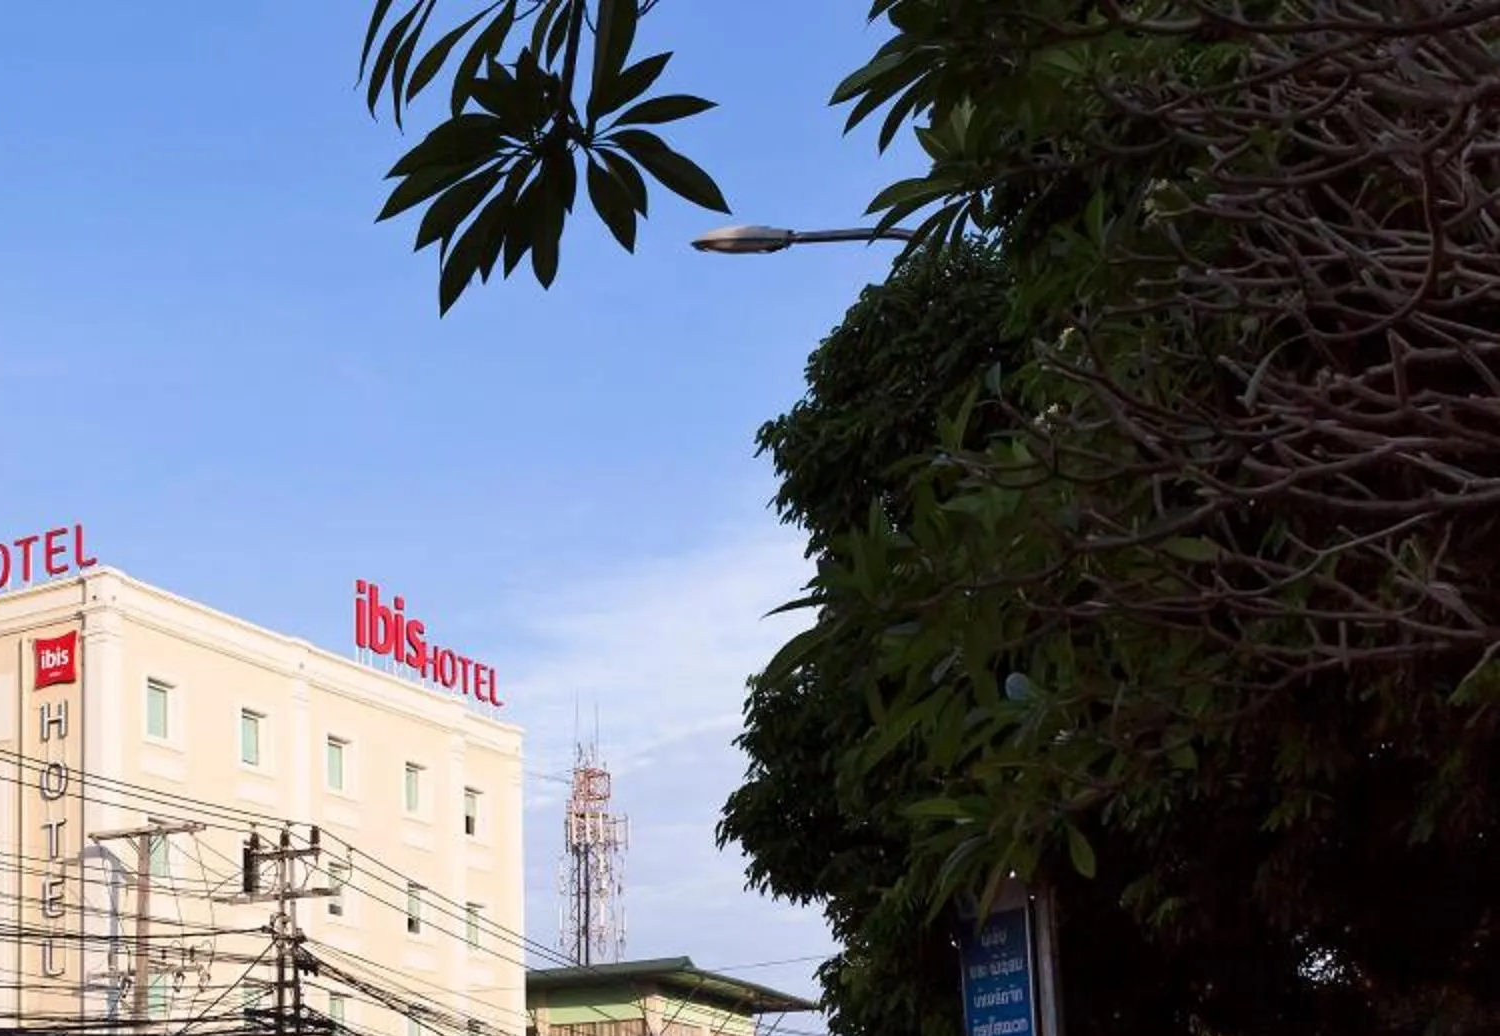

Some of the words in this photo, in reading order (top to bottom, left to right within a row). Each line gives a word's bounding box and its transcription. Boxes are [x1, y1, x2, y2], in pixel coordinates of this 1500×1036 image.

[41, 646, 69, 669] ibis
[356, 579, 424, 668] ibis
[421, 641, 504, 706] HOTEL
[40, 699, 69, 978] HOTEL
